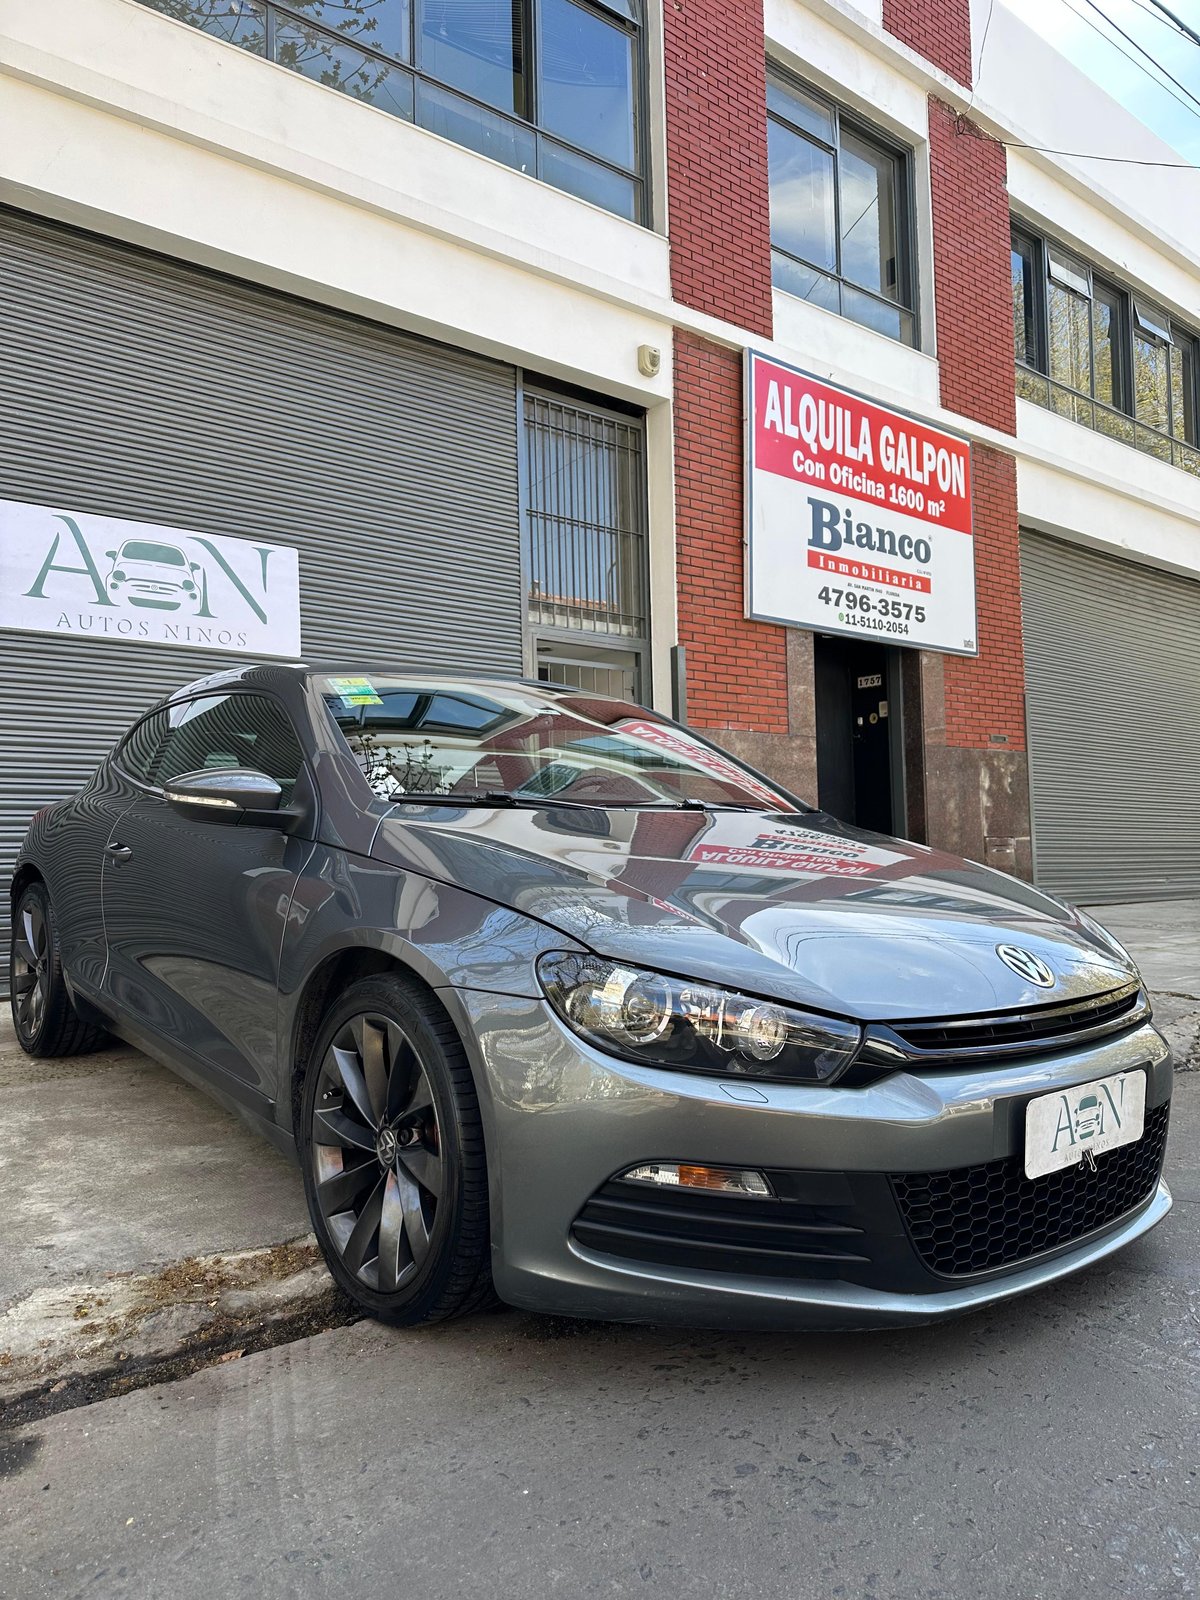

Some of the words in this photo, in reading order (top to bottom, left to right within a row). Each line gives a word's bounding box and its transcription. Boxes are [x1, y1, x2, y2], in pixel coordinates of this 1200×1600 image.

[763, 379, 874, 467] ALQUILA
[879, 425, 966, 499] GALPON
[792, 450, 826, 481] Con
[829, 462, 885, 500] Oficina
[889, 484, 924, 512] 1600
[807, 496, 932, 564] Bianco
[819, 556, 923, 590] Inmobiliaria
[818, 586, 926, 623] 4796-3575
[56, 611, 149, 637] AUTOS
[164, 623, 248, 648] NINOS
[845, 613, 909, 635] 11-5110-2054
[858, 676, 881, 687] 1757
[996, 944, 1055, 988] VW
